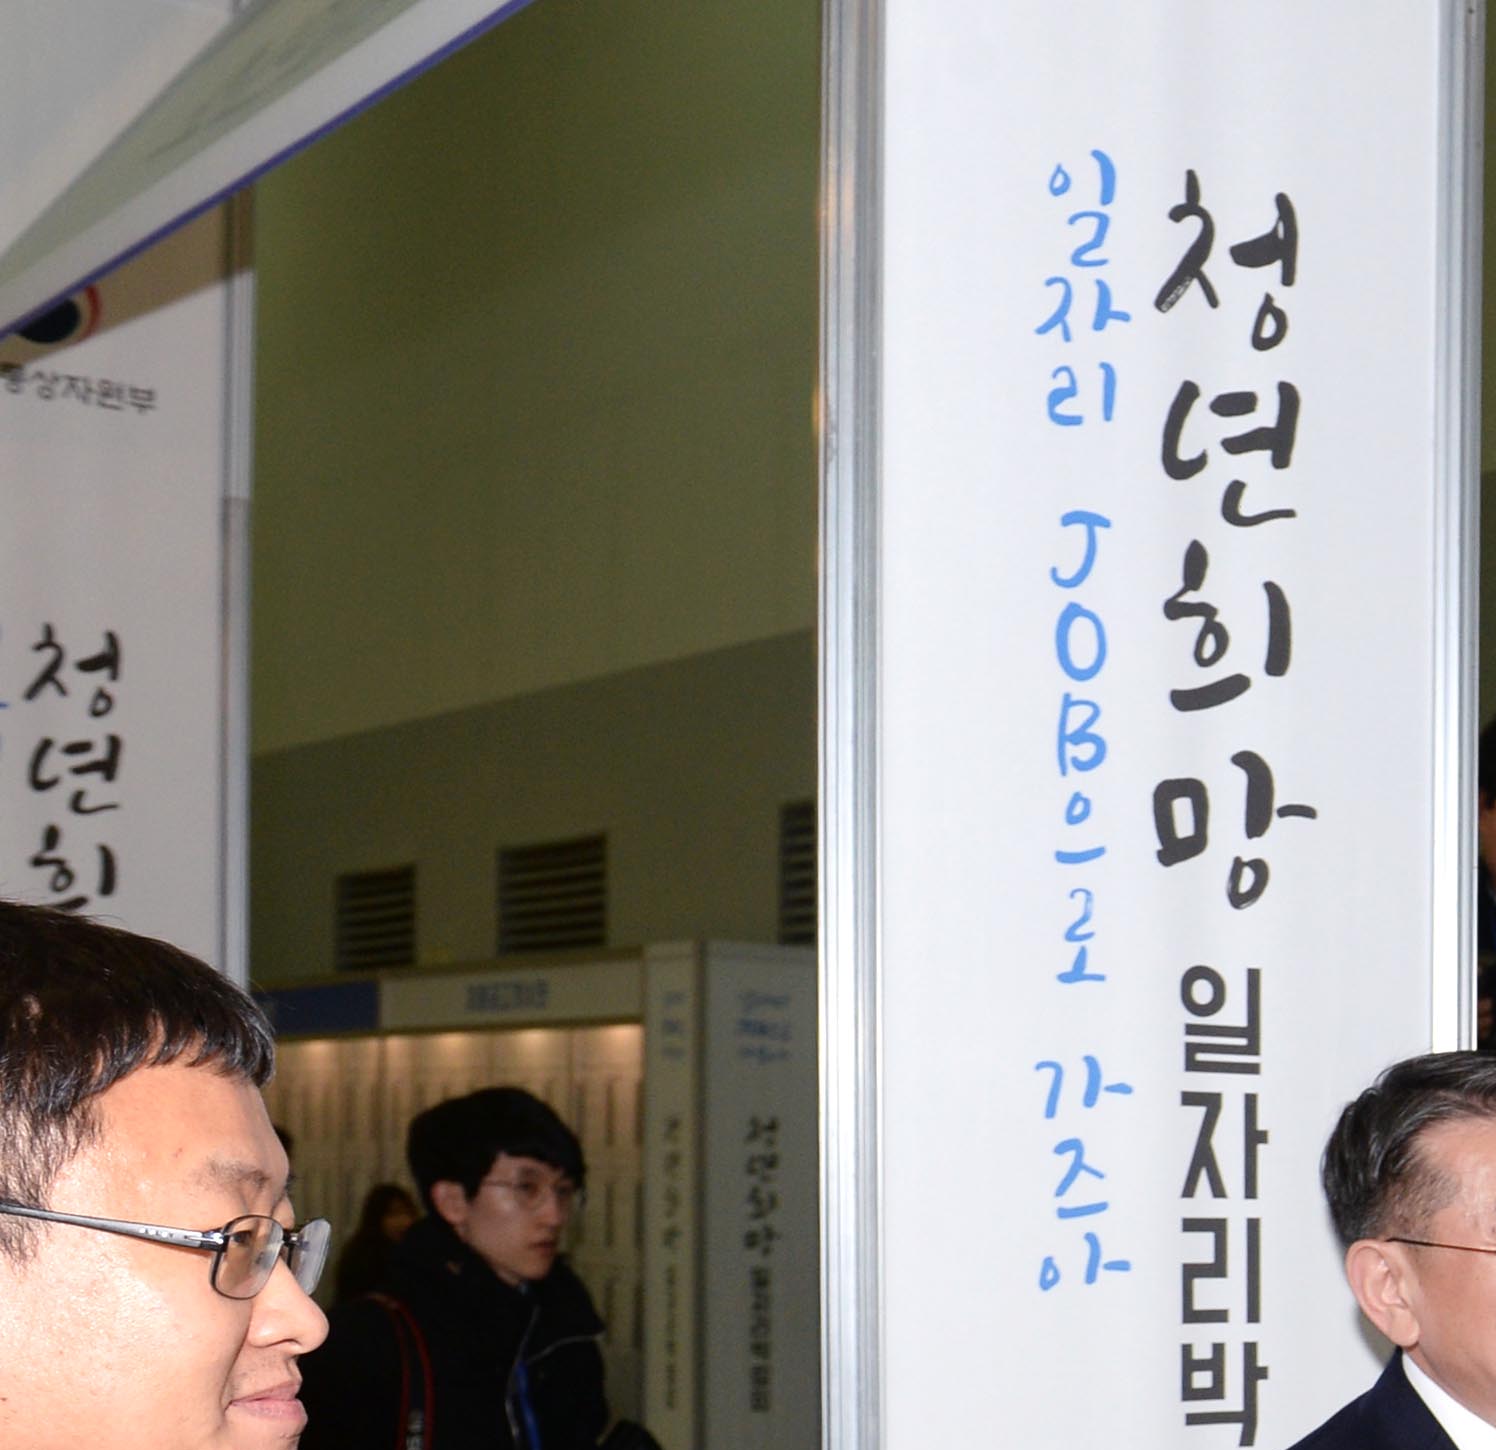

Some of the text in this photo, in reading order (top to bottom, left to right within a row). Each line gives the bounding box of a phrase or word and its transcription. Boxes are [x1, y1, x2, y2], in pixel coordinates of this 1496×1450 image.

[1033, 149, 1136, 1292] 일자리 JOB으로 가즈아
[1152, 168, 1319, 910] 청년희망
